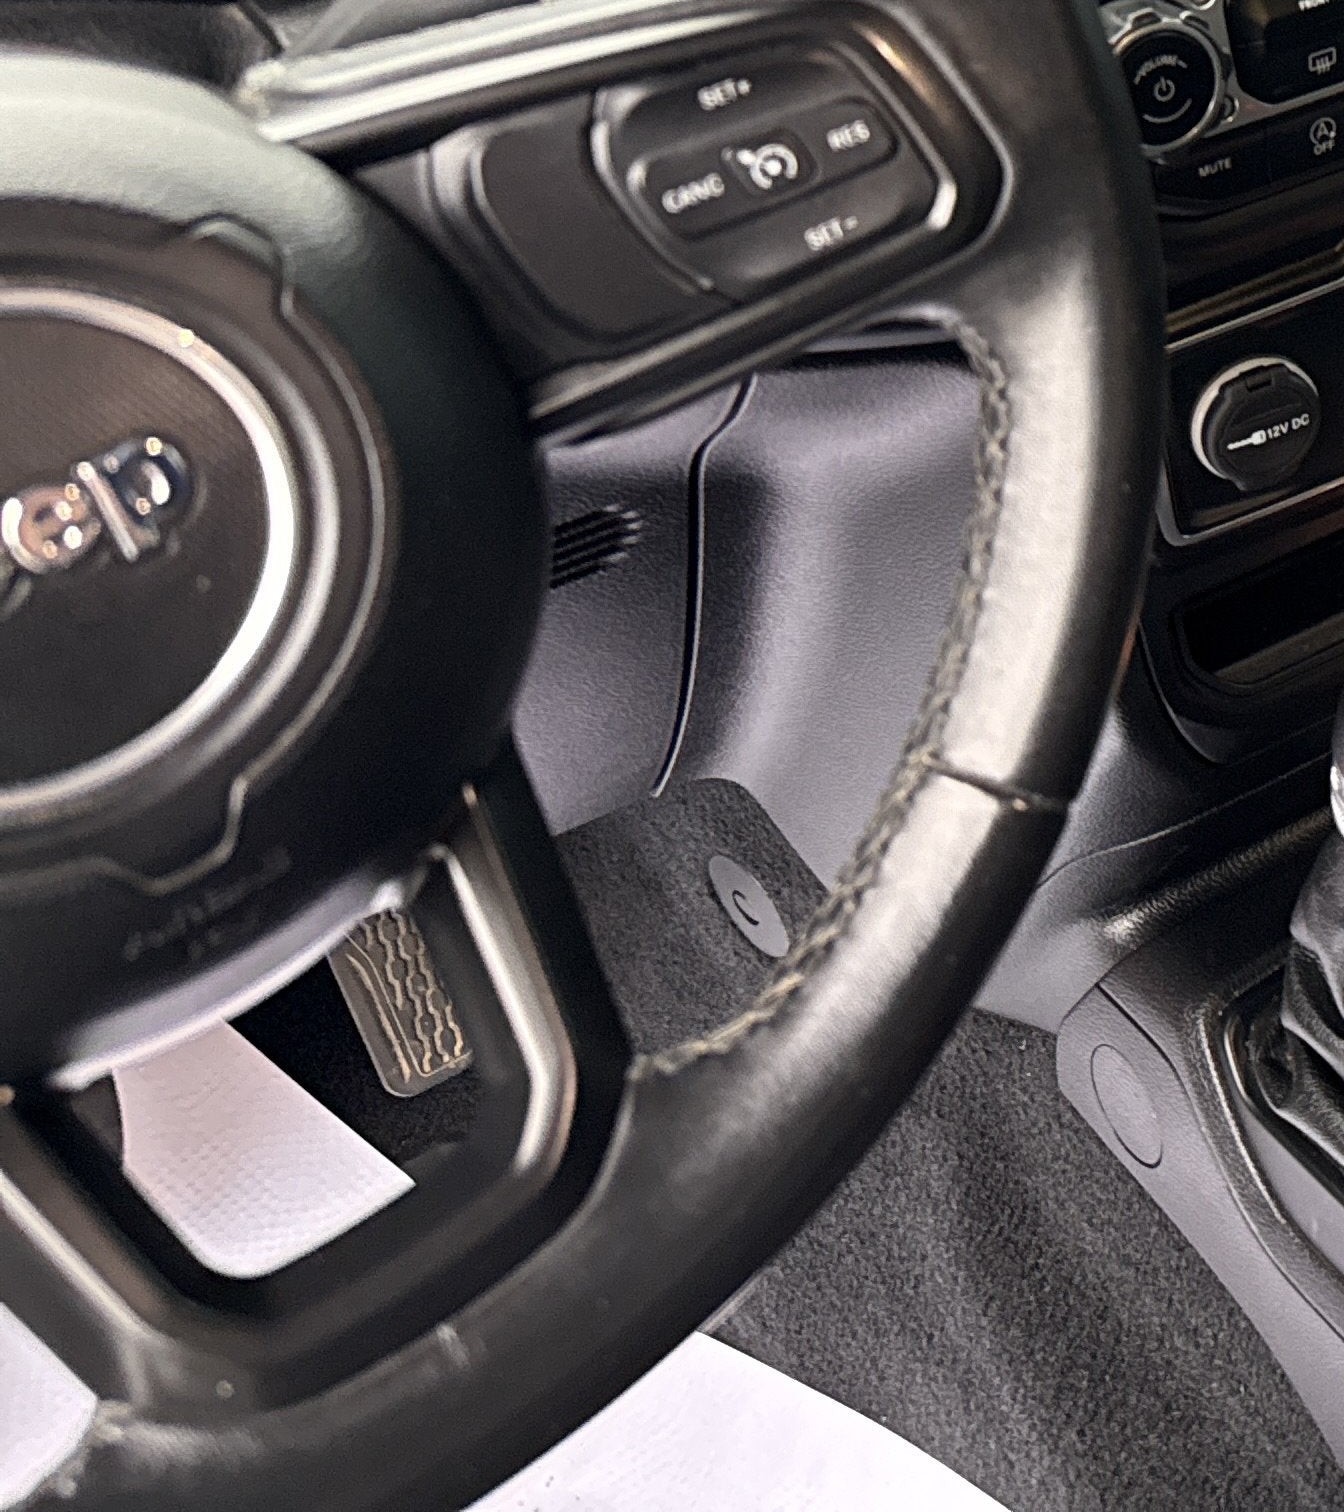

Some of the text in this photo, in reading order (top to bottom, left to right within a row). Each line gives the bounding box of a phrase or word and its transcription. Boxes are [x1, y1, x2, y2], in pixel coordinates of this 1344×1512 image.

[1313, 139, 1336, 156] OFF
[1199, 156, 1232, 178] MUTE
[1267, 412, 1310, 439] 12V DC
